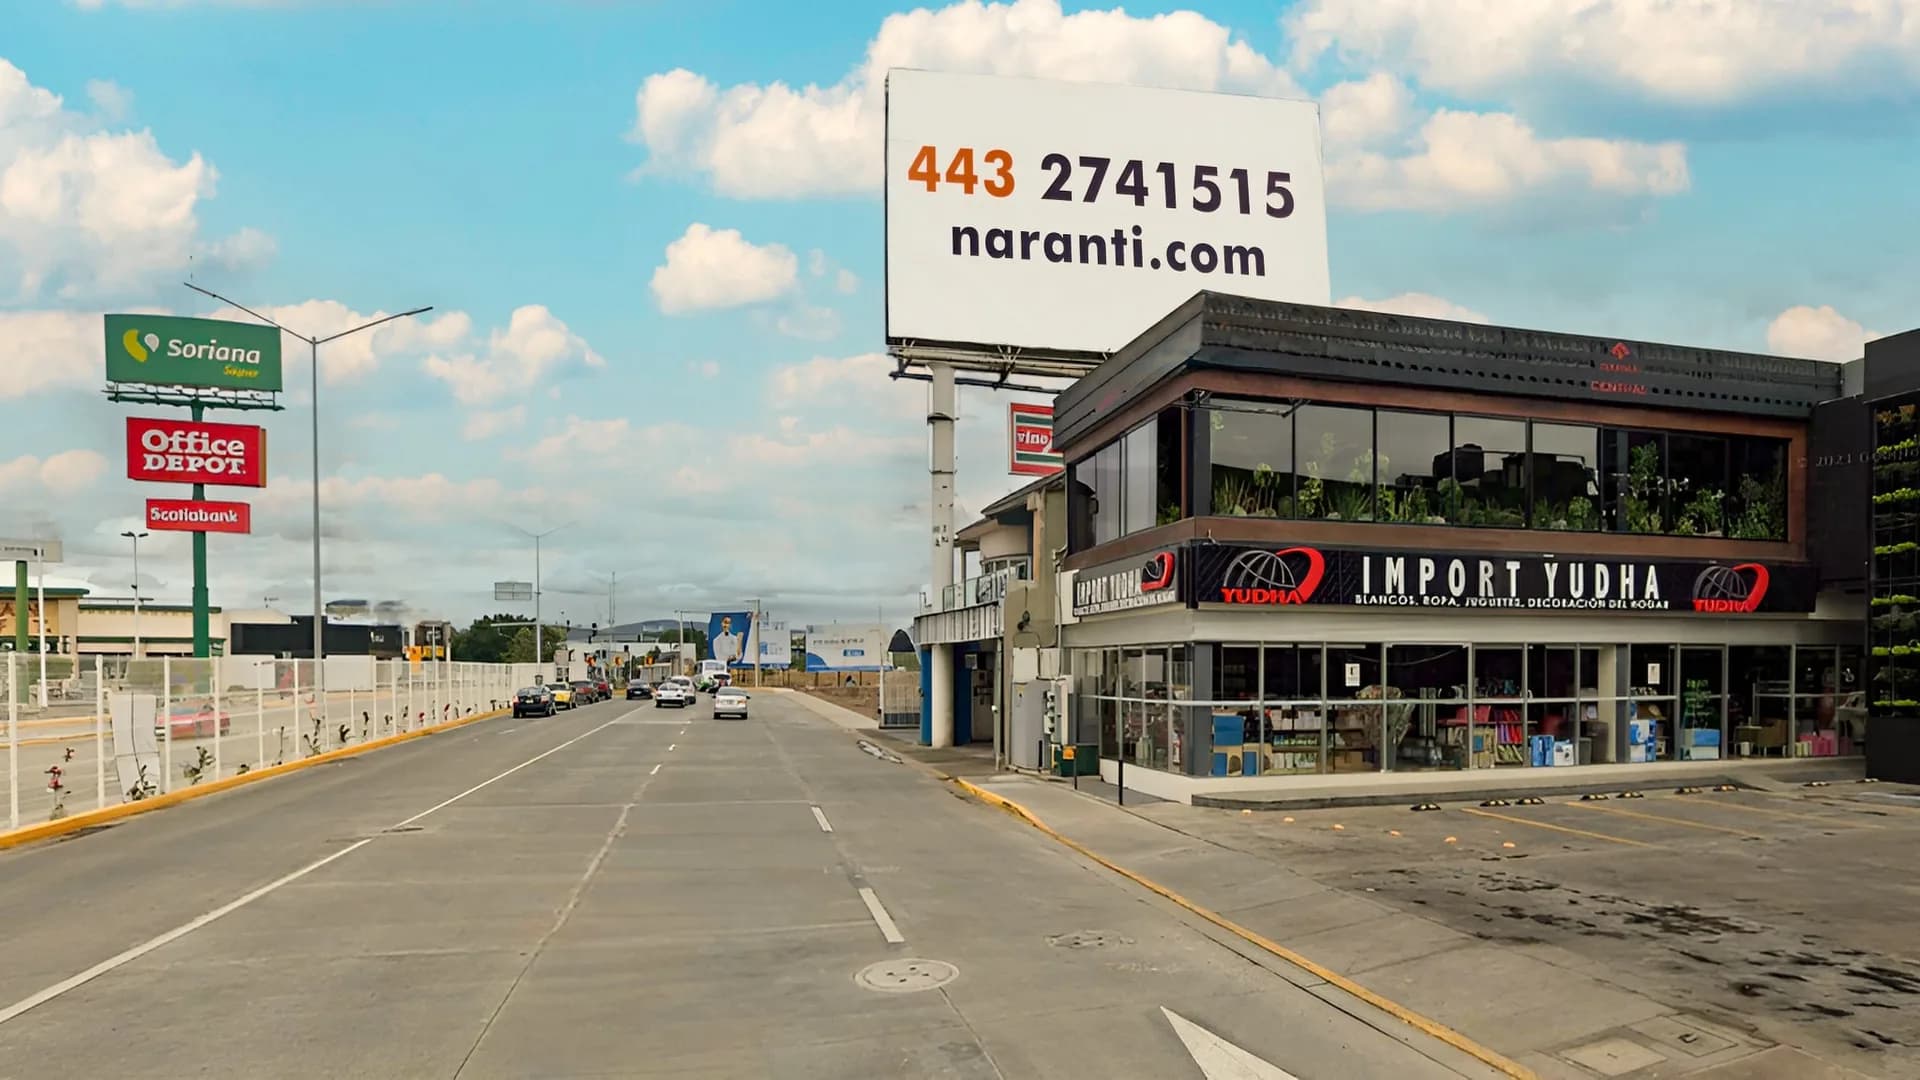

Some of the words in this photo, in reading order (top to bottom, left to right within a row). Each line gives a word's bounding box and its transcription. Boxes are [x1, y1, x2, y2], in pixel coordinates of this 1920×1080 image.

[907, 145, 1015, 199] 443
[1040, 153, 1295, 219] 2741515
[951, 224, 1266, 277] naranti.com
[167, 339, 260, 364] Soriana
[141, 429, 245, 456] Office
[151, 507, 238, 523] Scotiabank
[1362, 556, 1520, 598] IMPORT
[1543, 561, 1659, 600] YUDHA
[1221, 588, 1303, 605] YUDHA
